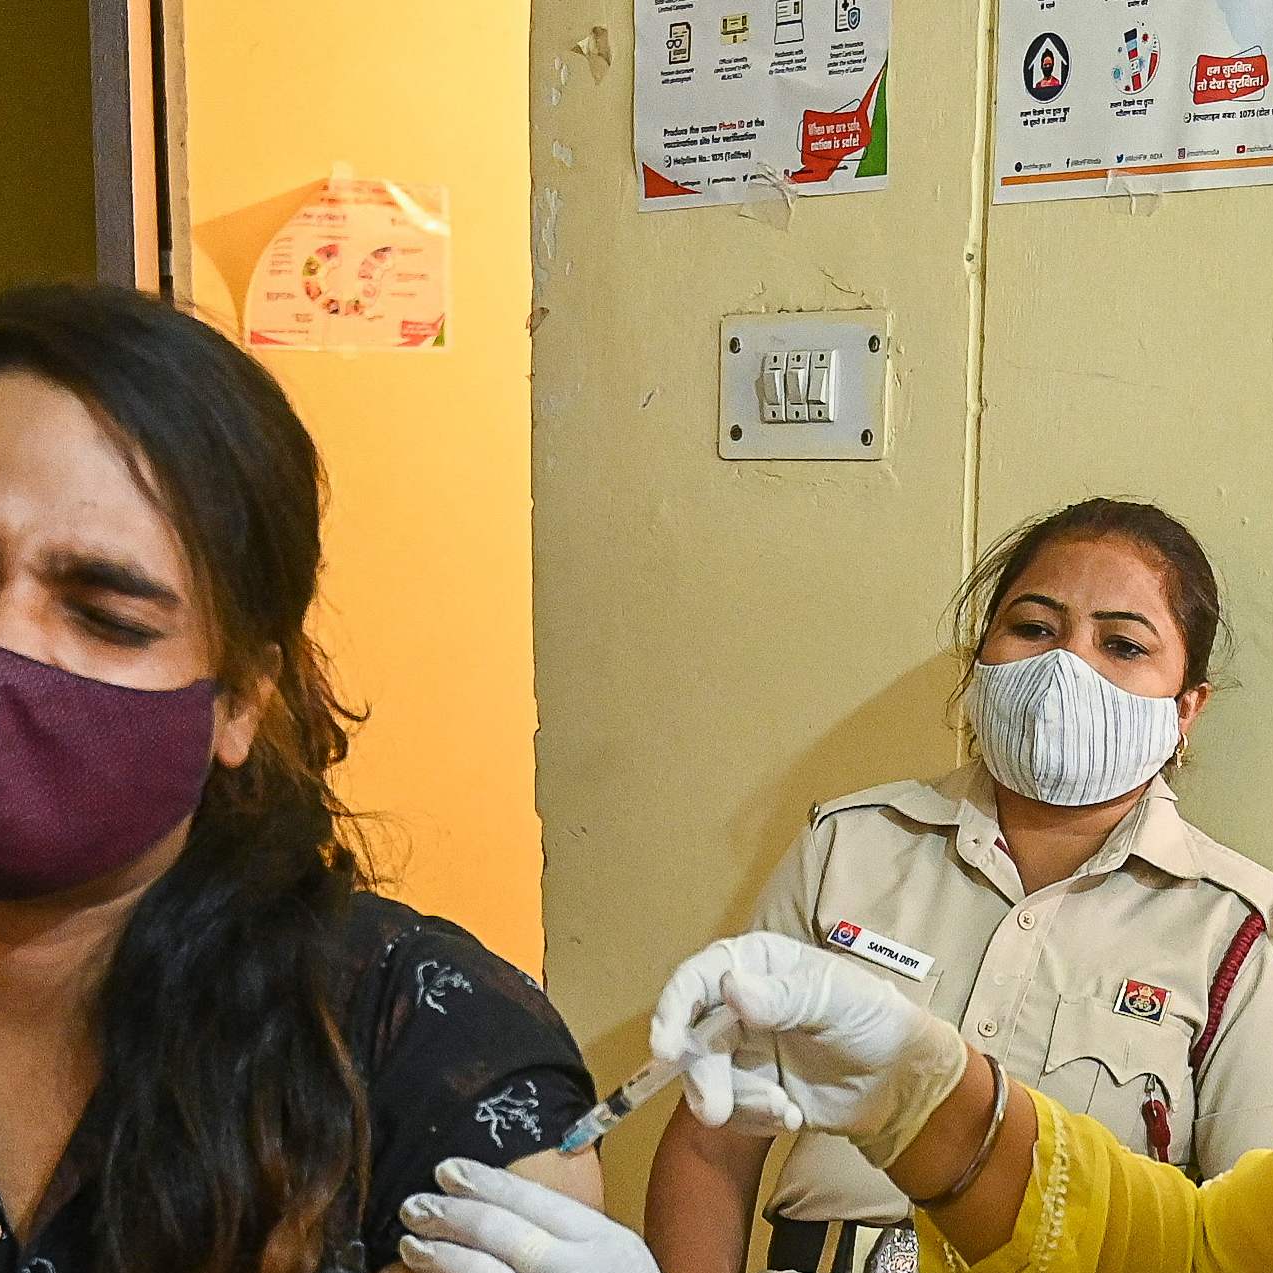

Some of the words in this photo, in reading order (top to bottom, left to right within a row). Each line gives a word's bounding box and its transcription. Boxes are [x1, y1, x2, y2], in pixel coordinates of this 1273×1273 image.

[1206, 65, 1221, 76] हम
[1221, 61, 1255, 77] सुरक्षित,
[1196, 77, 1207, 91] तो
[1208, 76, 1226, 90] देश
[663, 126, 688, 137] Produce
[689, 125, 699, 134] the
[701, 125, 717, 133] same
[718, 121, 737, 131] Photo
[738, 120, 745, 129] ID
[746, 119, 753, 128] at
[754, 117, 765, 127] the
[807, 122, 825, 136] When
[825, 123, 835, 134] we
[835, 123, 847, 133] are
[847, 116, 862, 133] safe,
[663, 137, 698, 149] vaccination
[699, 136, 711, 145] site
[711, 134, 721, 144] for
[722, 131, 757, 143] verification
[810, 138, 832, 151] nation
[833, 136, 840, 149] is
[841, 133, 860, 148] safe!
[673, 155, 697, 166] Helpline
[711, 153, 724, 162] 1075
[867, 941, 899, 960] SANTRA
[899, 954, 920, 969] DEVI
